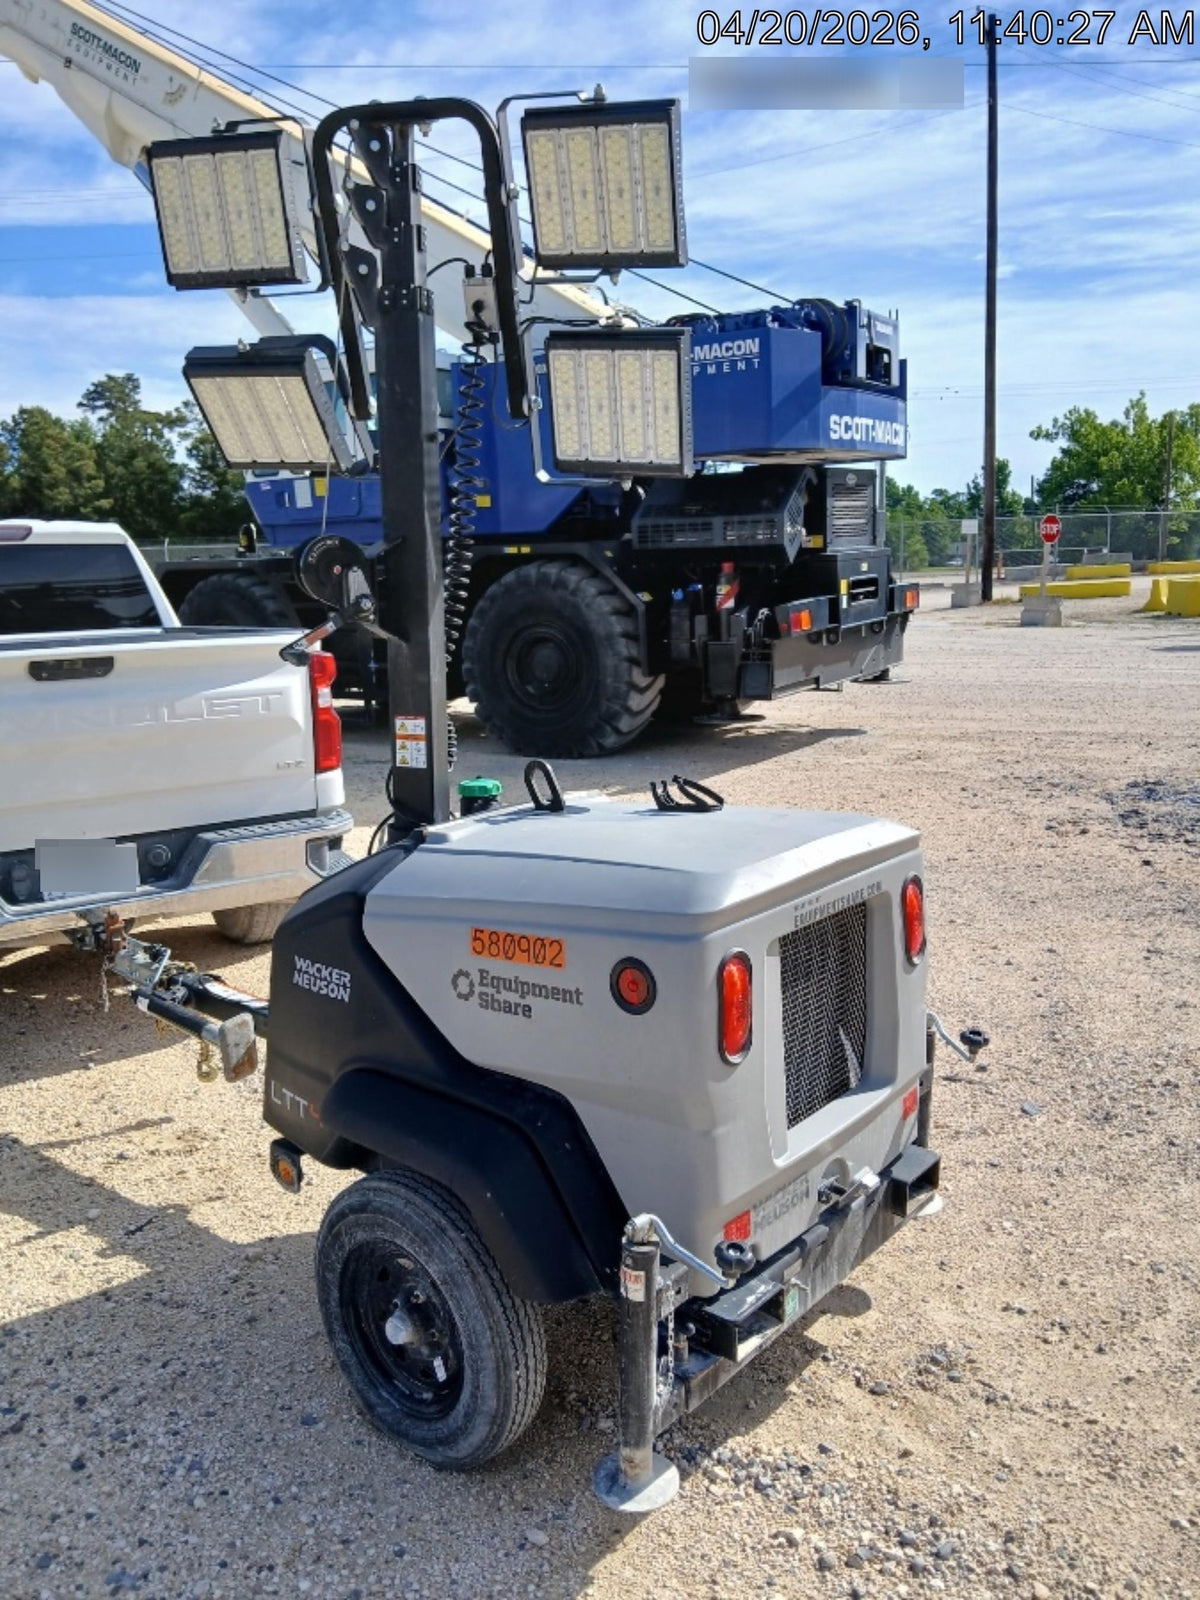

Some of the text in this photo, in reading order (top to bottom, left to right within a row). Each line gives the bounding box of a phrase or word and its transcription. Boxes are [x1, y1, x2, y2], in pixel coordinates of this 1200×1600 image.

[70, 22, 141, 73] SCOTT-MACON
[471, 928, 563, 968] 580902
[293, 970, 349, 1003] NEUSON
[294, 955, 351, 986] WACKER
[478, 968, 584, 1006] Equipment
[478, 991, 532, 1019] Share
